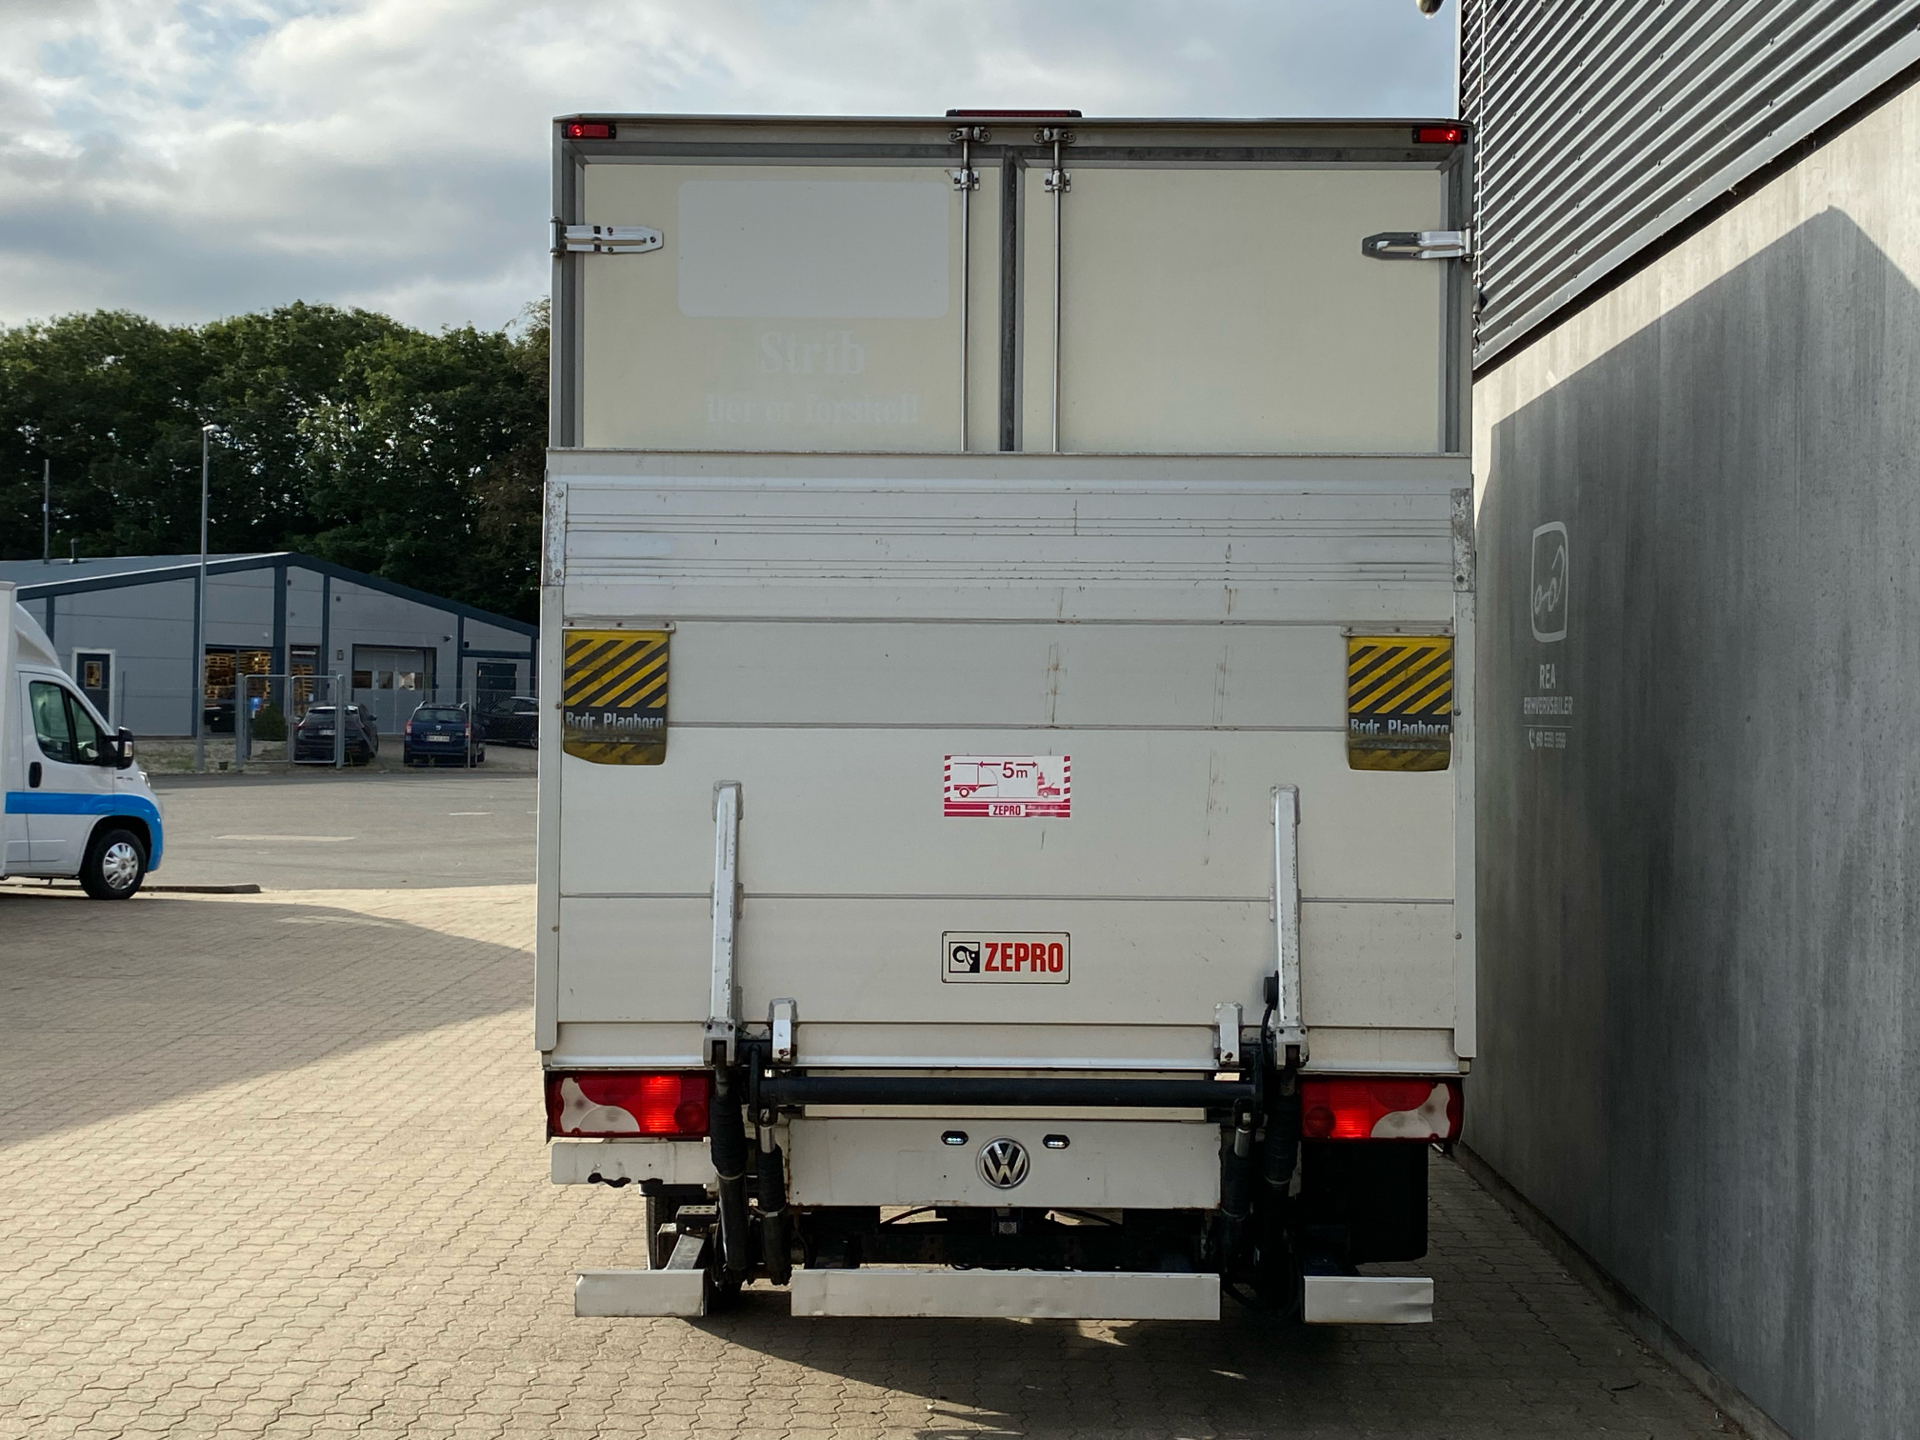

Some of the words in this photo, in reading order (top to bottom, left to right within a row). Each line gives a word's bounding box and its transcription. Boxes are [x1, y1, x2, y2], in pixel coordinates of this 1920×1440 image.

[760, 330, 865, 374] Strib
[1539, 663, 1556, 689] REA
[992, 805, 1021, 816] ZEPRO
[984, 942, 1064, 973] ZEPRO
